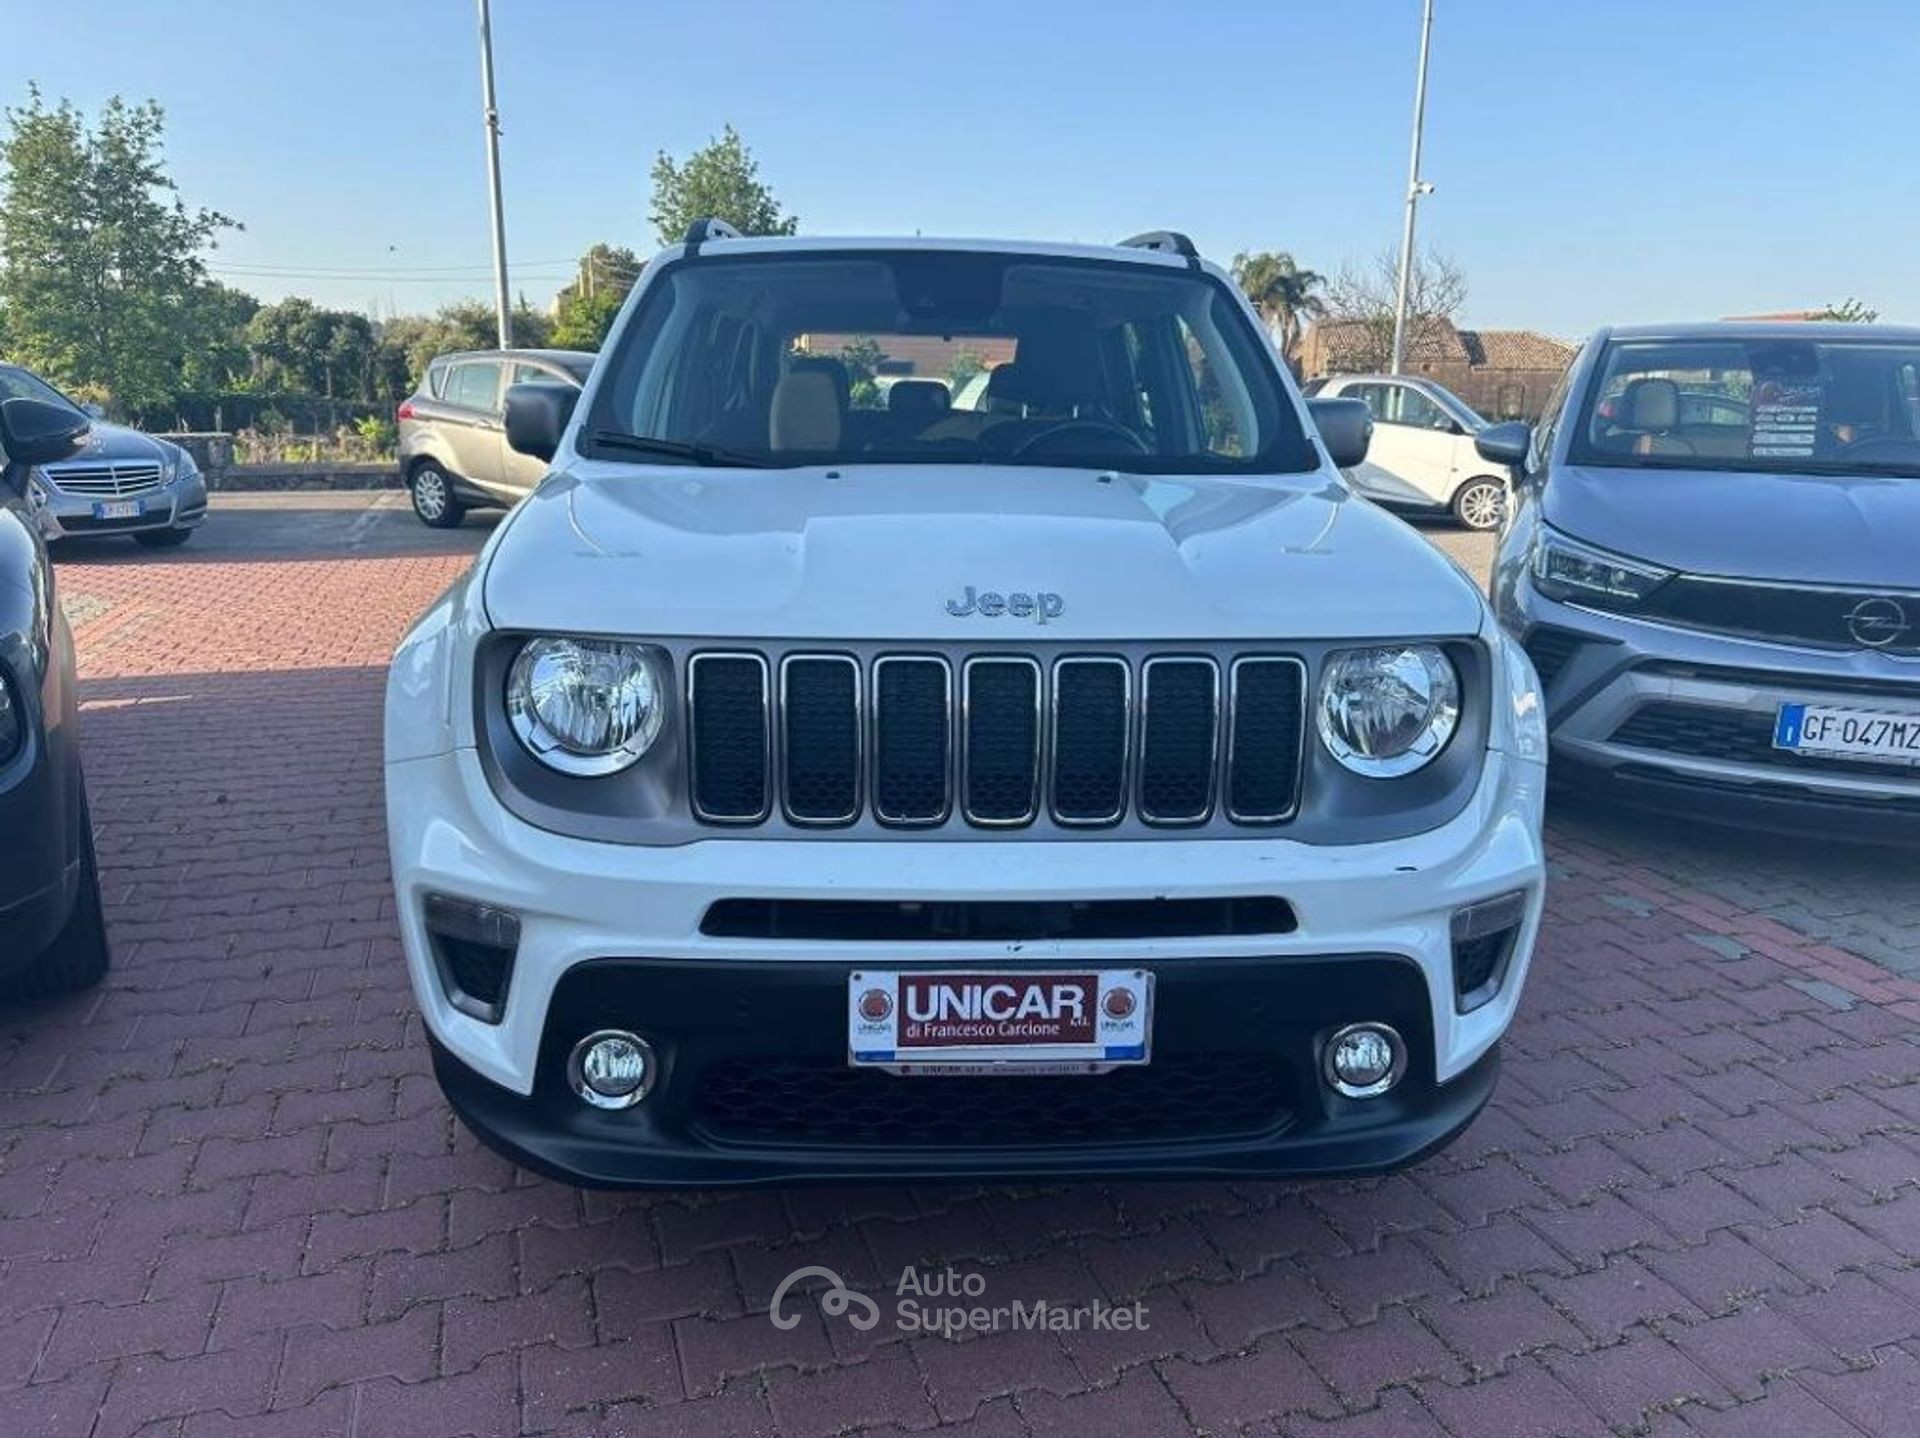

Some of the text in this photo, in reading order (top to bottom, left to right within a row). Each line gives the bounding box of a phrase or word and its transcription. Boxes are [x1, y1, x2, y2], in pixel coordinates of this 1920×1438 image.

[944, 585, 1065, 625] Jeep
[906, 984, 1085, 1022] UNICAR
[906, 1021, 1061, 1039] di Francesco Carcione
